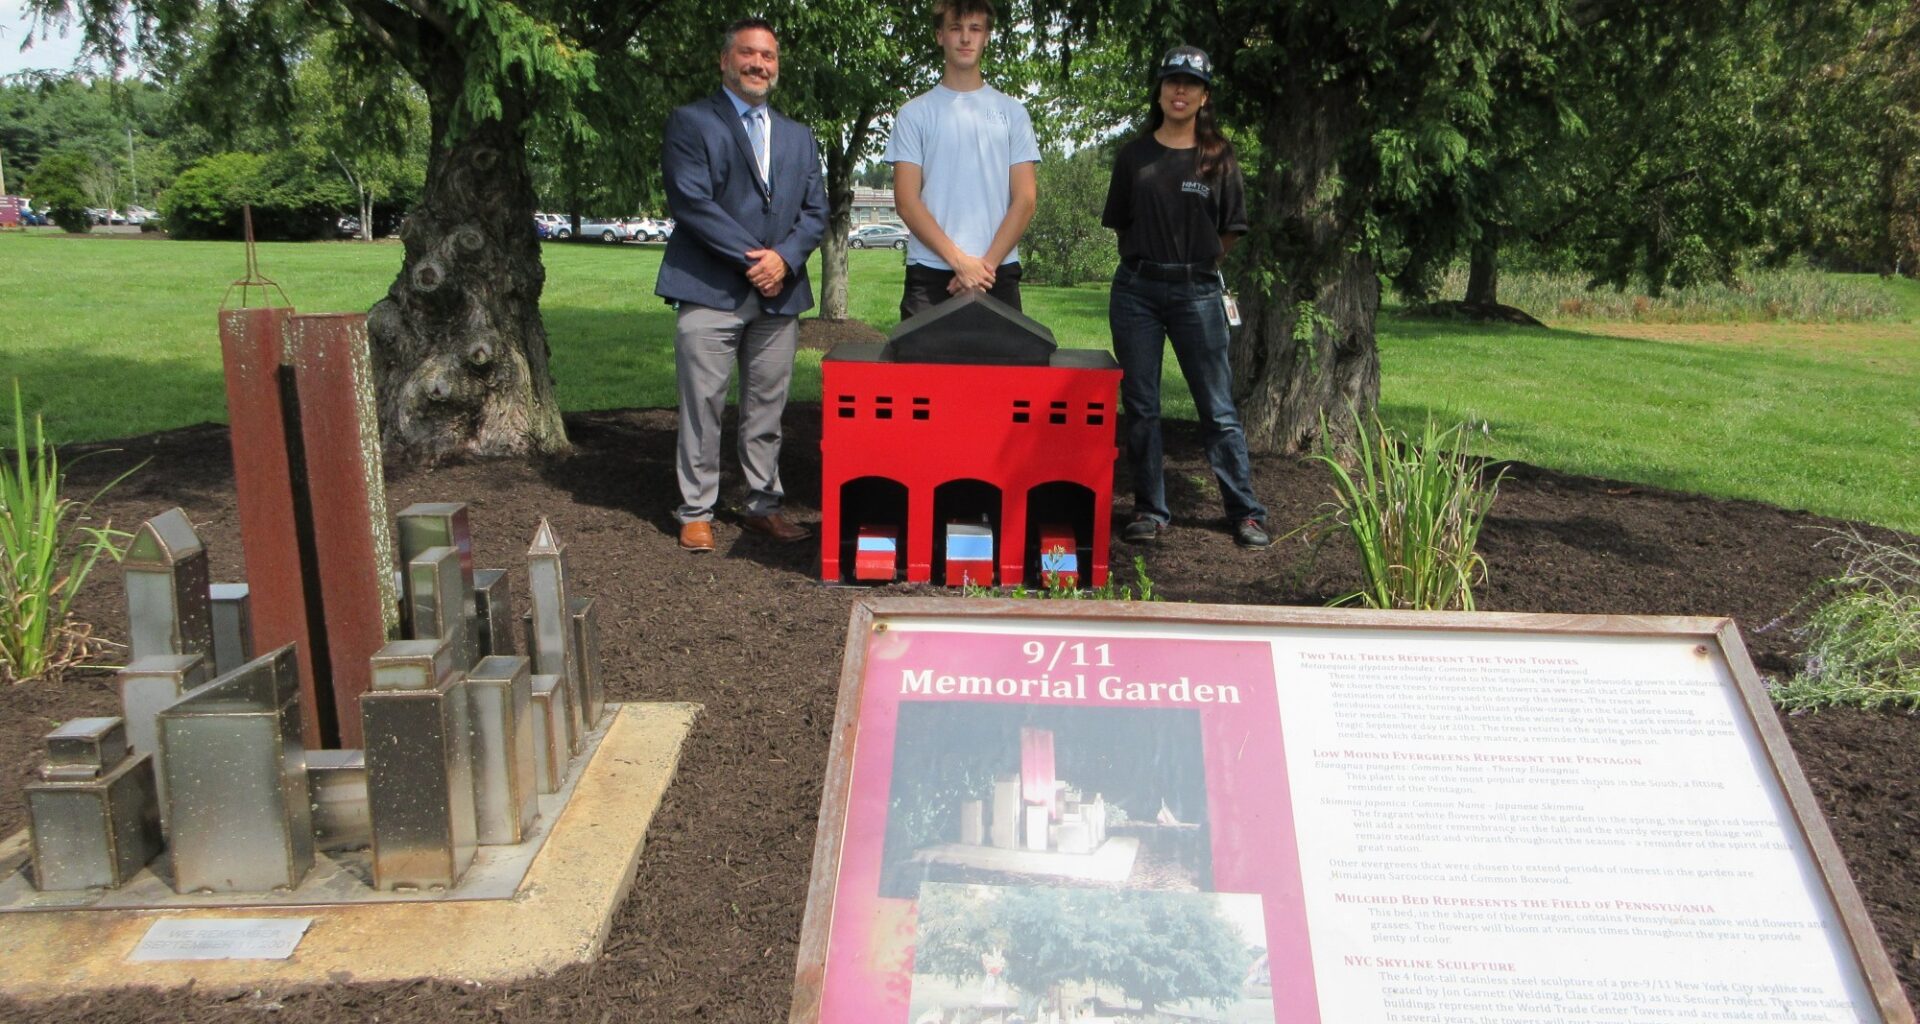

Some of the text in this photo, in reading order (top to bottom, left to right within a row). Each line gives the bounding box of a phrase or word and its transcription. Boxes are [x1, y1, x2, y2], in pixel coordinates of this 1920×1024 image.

[1023, 640, 1115, 671] 9/11
[900, 669, 1241, 703] Memorial Garden
[1356, 843, 1384, 853] great
[1328, 858, 1358, 867] Other
[1358, 861, 1419, 870] evergreens
[1419, 861, 1442, 869] that
[1472, 862, 1510, 871] chosen
[1524, 863, 1561, 872] extend
[1563, 864, 1604, 874] periods
[1619, 866, 1661, 874] interest
[1675, 867, 1694, 875] the
[1696, 868, 1735, 878] garden
[1330, 871, 1386, 881] Himalayan
[1387, 872, 1447, 881] Sarcococca
[1448, 873, 1467, 881] and
[1470, 874, 1518, 882] Common
[1368, 907, 1391, 916] This
[1430, 909, 1451, 918] the
[1450, 909, 1485, 920] shape
[1498, 911, 1518, 920] the
[1576, 913, 1624, 922] contains
[1623, 914, 1697, 926] Pennsylvania
[1696, 916, 1732, 925] native
[1734, 917, 1760, 926] wild
[1760, 918, 1804, 927] flowers
[1372, 932, 1407, 944] plenty
[1413, 921, 1437, 930] The
[1437, 922, 1479, 931] flowers
[1480, 923, 1503, 932] will
[1503, 923, 1541, 933] bloom
[1554, 925, 1596, 934] various
[1598, 926, 1629, 935] times
[1631, 927, 1694, 938] throughout
[1694, 929, 1715, 938] the
[1715, 931, 1741, 940] year
[1757, 930, 1801, 941] provide
[1378, 971, 1401, 981] The
[1412, 972, 1459, 982] foot-tall
[1459, 974, 1509, 984] stainless
[1511, 975, 1537, 985] steel
[1540, 976, 1594, 988] sculpture
[1620, 979, 1672, 990] pre-9/11
[1674, 980, 1699, 990] New
[1700, 981, 1729, 991] York
[1731, 982, 1753, 993] City
[1754, 983, 1798, 994] skyline
[1381, 985, 1424, 995] created
[1439, 987, 1462, 996] Jon
[1462, 987, 1508, 997] Garnett
[1564, 990, 1596, 1000] Class
[1610, 992, 1646, 1002] 2003)
[1663, 993, 1682, 1003] his
[1682, 994, 1722, 1004] Senior
[1768, 997, 1793, 1006] The
[1794, 997, 1818, 1007] two
[1383, 999, 1437, 1011] buildings
[1438, 1000, 1494, 1012] represent
[1494, 1002, 1516, 1012] the
[1515, 1002, 1553, 1013] World
[1552, 1004, 1588, 1014] Trade
[1590, 1005, 1628, 1015] Center
[1629, 1006, 1674, 1016] Towers
[1677, 1007, 1698, 1017] and
[1700, 1010, 1720, 1018] are
[1720, 1008, 1754, 1018] made
[1770, 1010, 1798, 1020] mild
